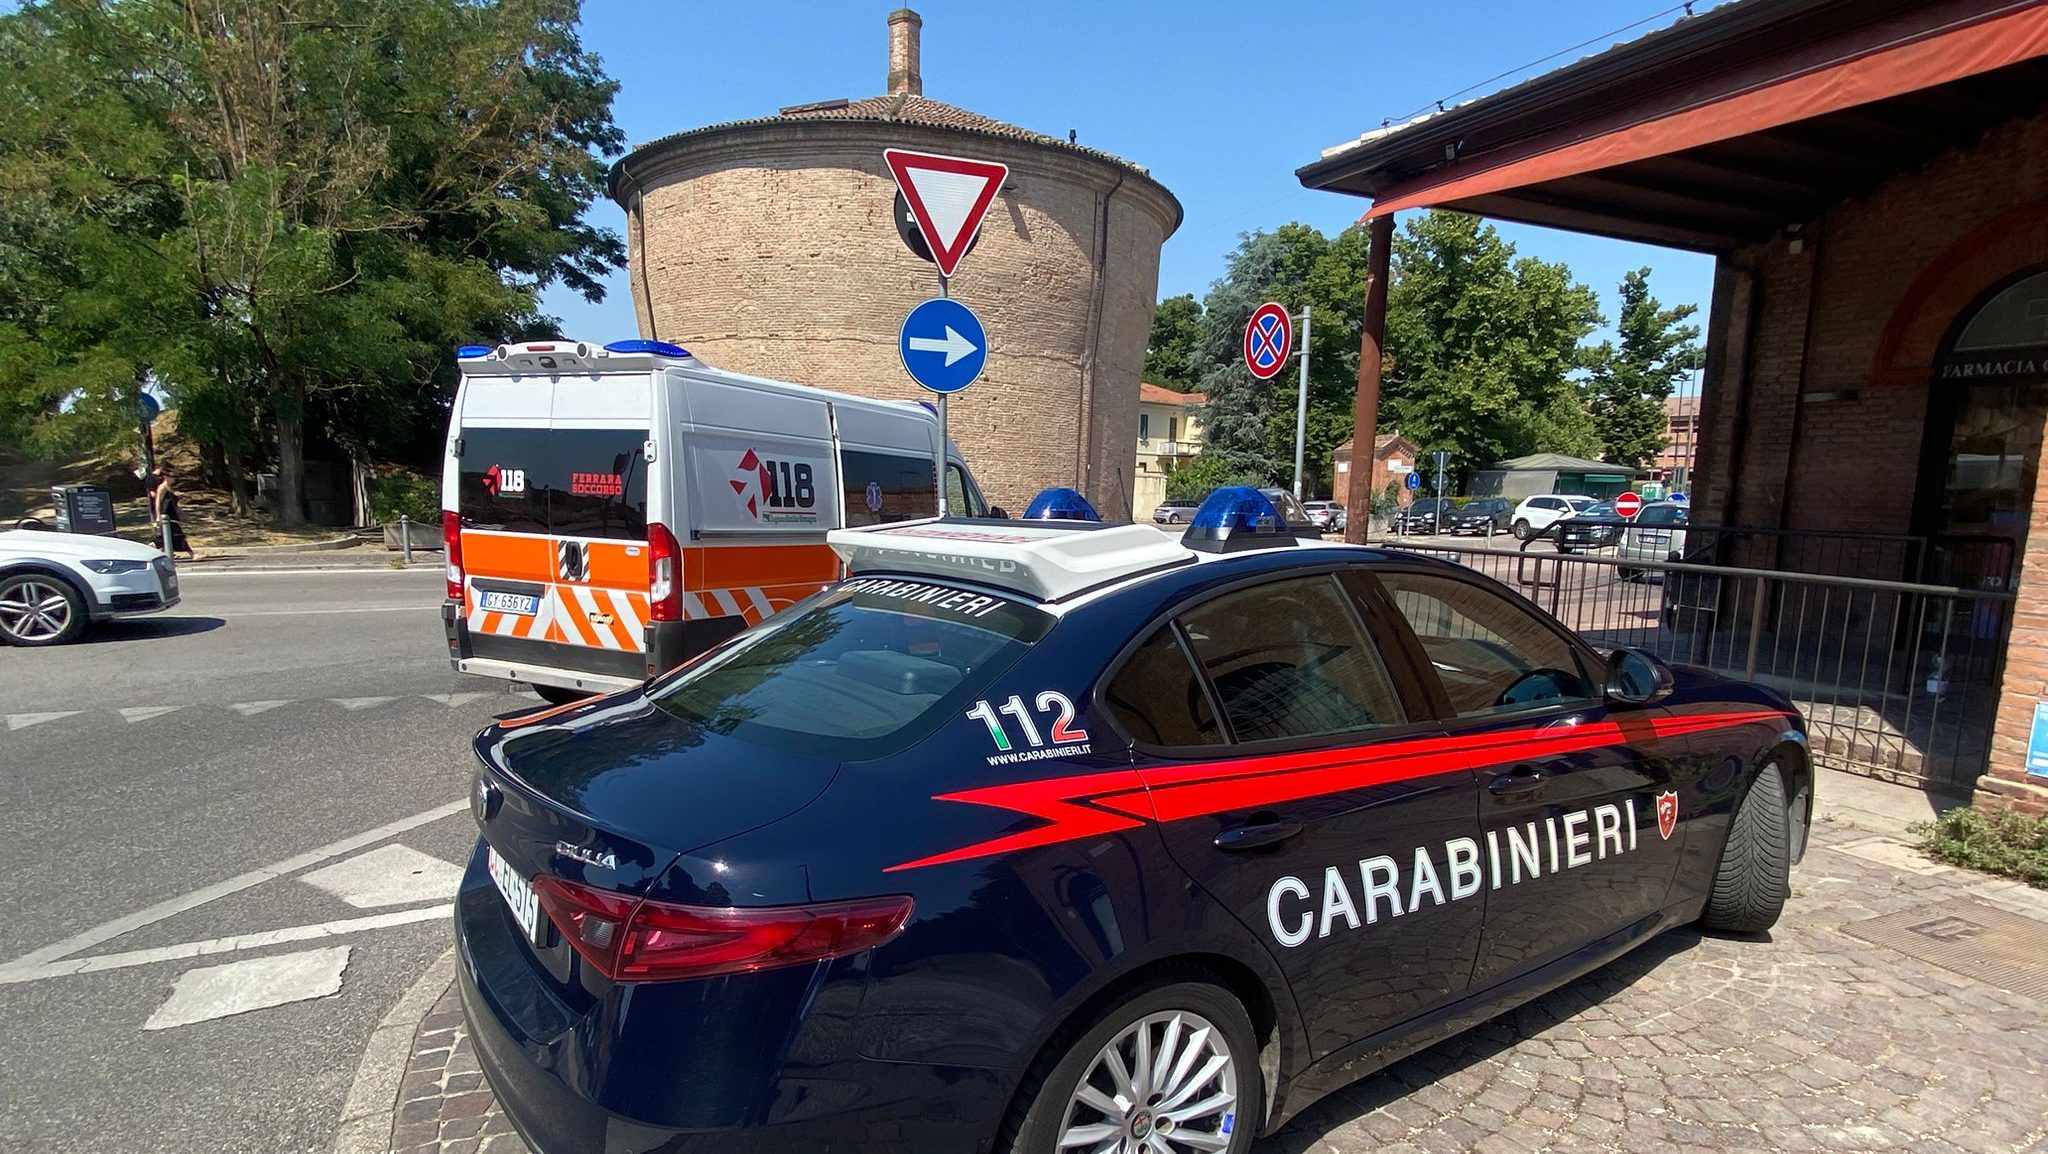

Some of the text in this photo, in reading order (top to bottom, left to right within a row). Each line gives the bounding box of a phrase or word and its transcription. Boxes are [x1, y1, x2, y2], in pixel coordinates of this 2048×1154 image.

[1942, 359, 2035, 378] FARMACIA
[500, 469, 525, 492] 118
[572, 473, 622, 484] FERRARA
[572, 484, 622, 495] SOCCORSO
[766, 460, 815, 508] 118
[837, 578, 1006, 618] CARABINIERI
[966, 690, 1089, 751] 112
[986, 744, 1092, 766] WWW.CARABINIERI.IT
[1267, 799, 1637, 948] CARABINIERI
